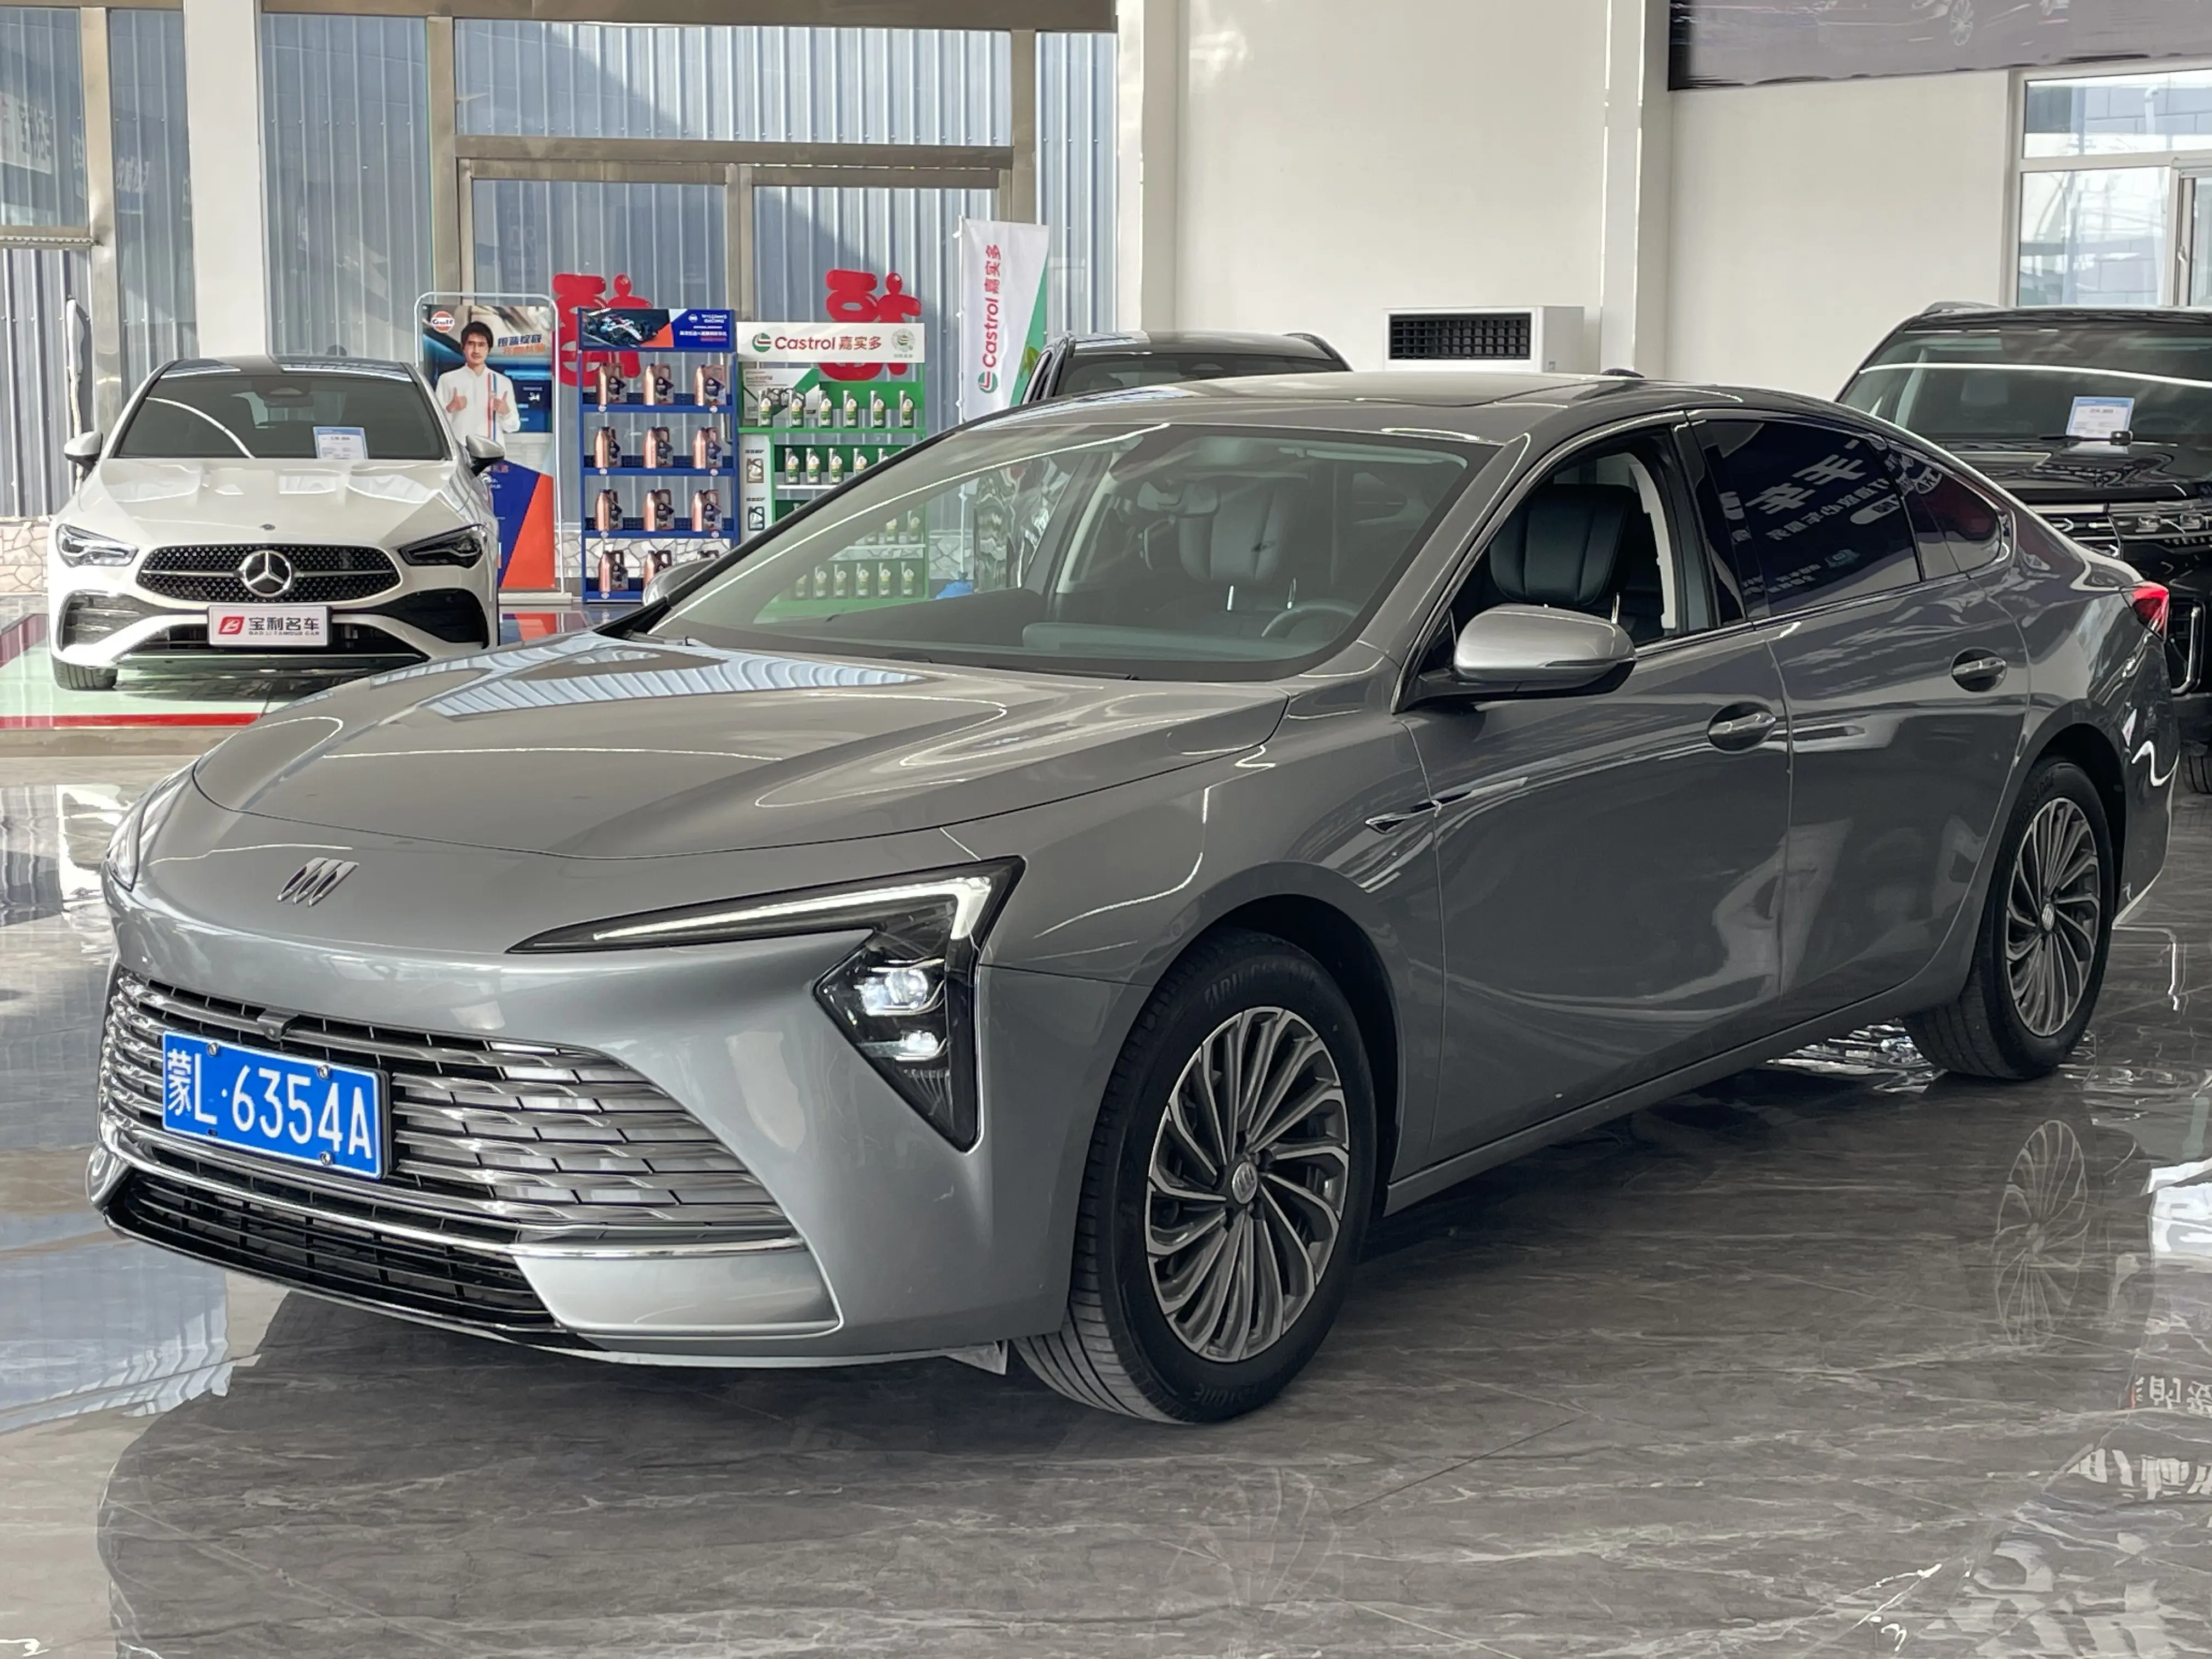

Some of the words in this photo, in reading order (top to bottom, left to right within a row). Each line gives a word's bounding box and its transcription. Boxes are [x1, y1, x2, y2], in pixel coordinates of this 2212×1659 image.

[984, 244, 1001, 294] 嘉实多
[983, 297, 998, 368] Castrol
[775, 336, 835, 350] Castrol
[839, 336, 882, 350] 嘉实多
[249, 617, 319, 630] 宝利名车
